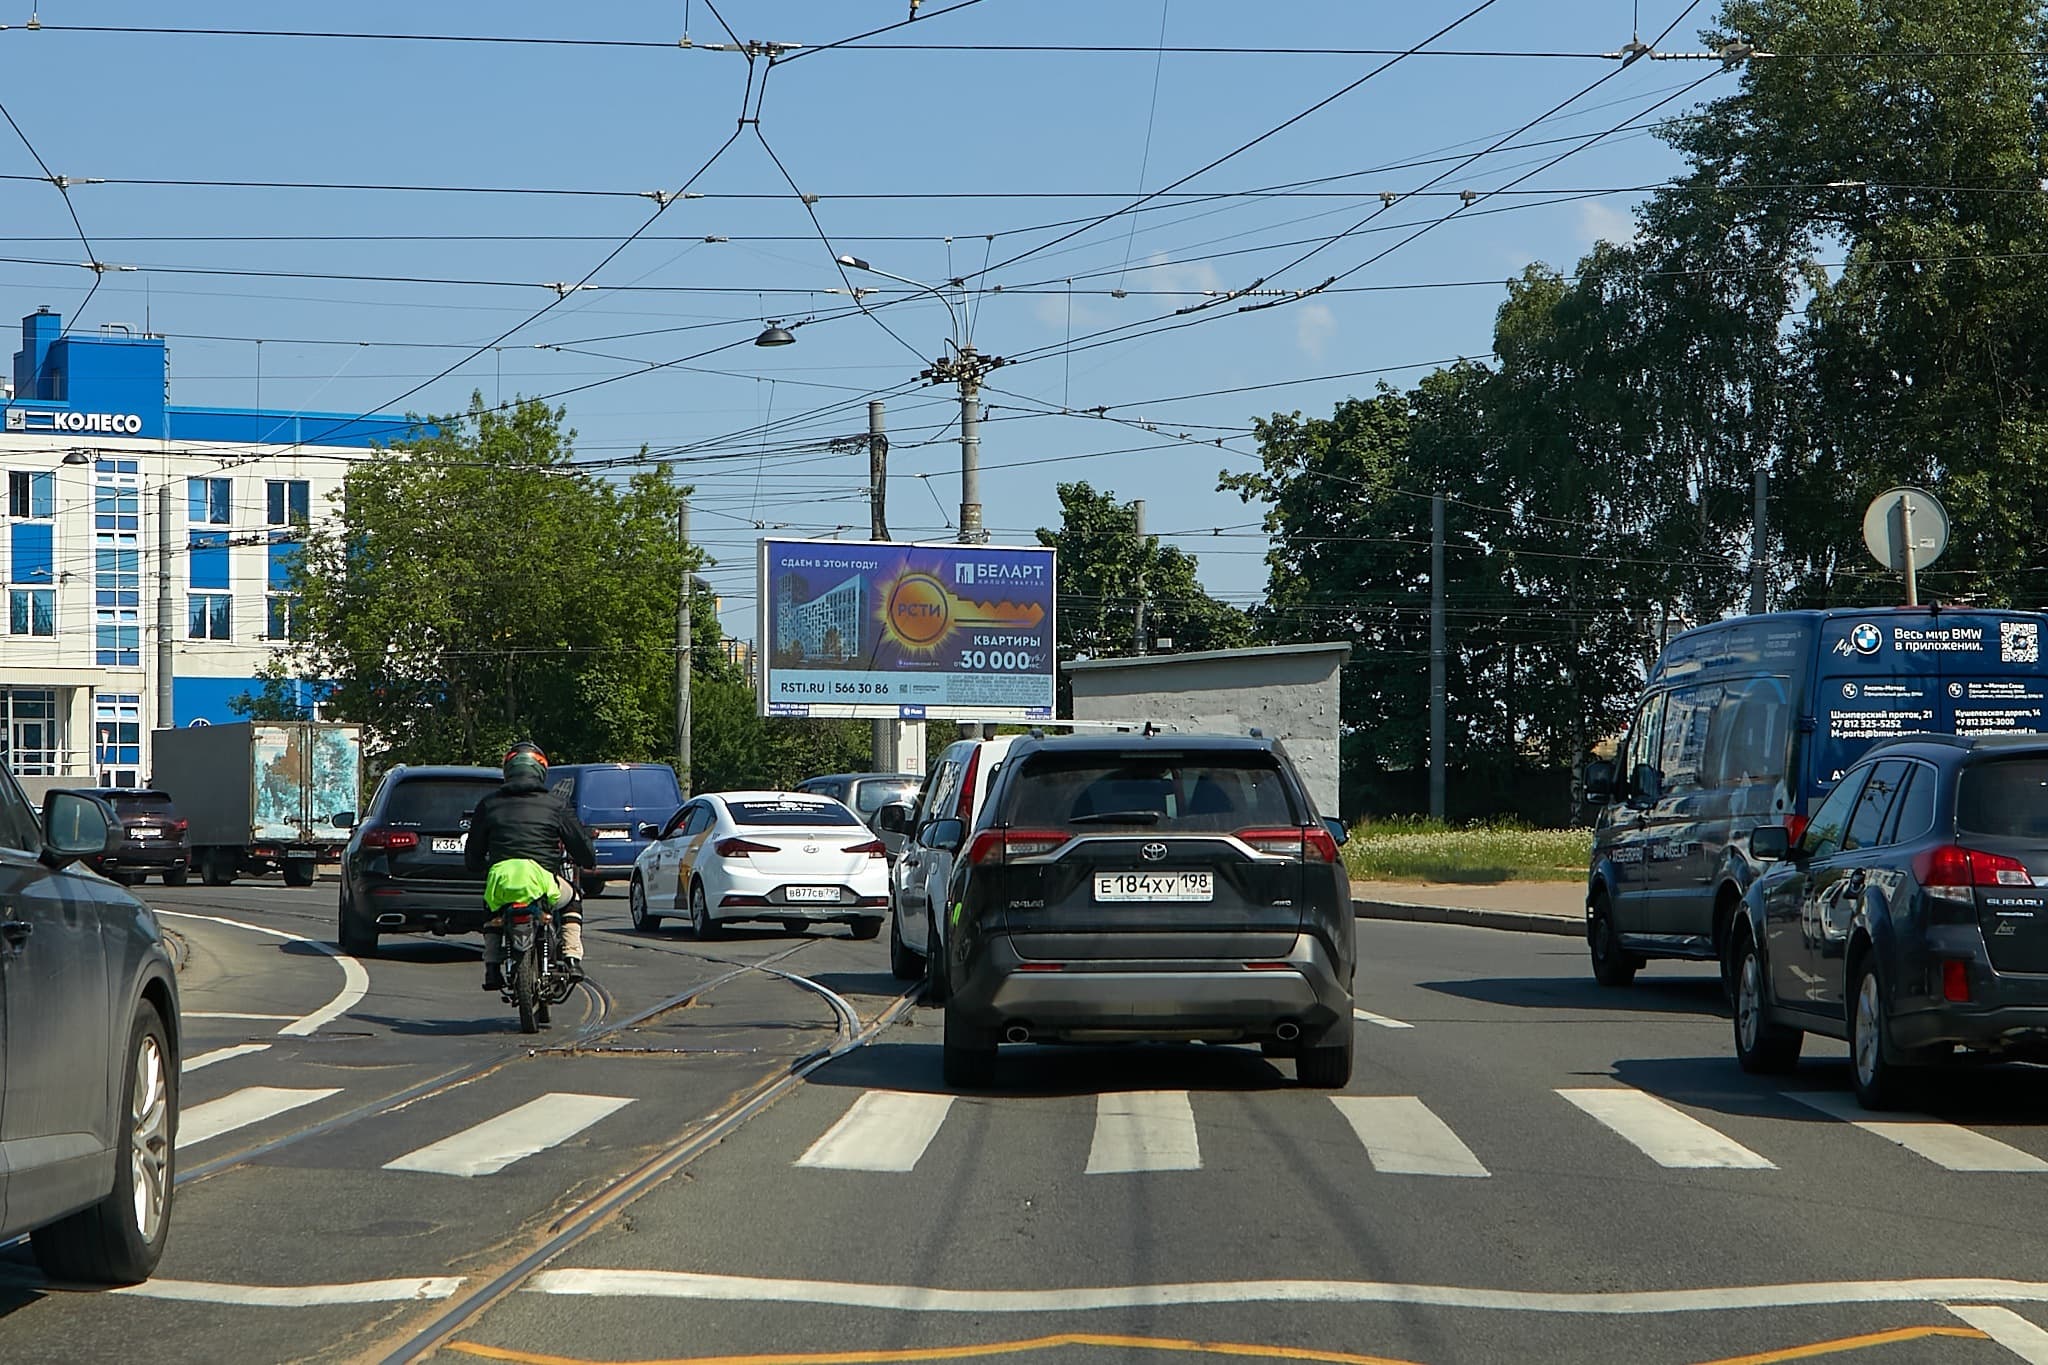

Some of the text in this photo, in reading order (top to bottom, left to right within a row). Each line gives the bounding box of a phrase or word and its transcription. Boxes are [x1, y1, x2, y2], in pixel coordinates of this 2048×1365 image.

[54, 411, 142, 433] КОЛЕСО
[781, 558, 812, 568] СДАЕМ
[823, 560, 848, 568] ЭТОМ
[850, 560, 878, 570] ГОДУ!
[977, 563, 1044, 579] БЕЛАРТ
[897, 603, 940, 617] РСТИ
[973, 635, 1040, 647] КВАРТИРЫ
[1894, 628, 1982, 643] Весь мир BMW
[1895, 640, 1983, 653] в приложении.
[960, 650, 986, 669] 30
[989, 650, 1030, 670] 000
[781, 682, 889, 694] RSTI.RU 566 30 86
[1830, 710, 1933, 721] Шкиперский проток, 21
[2032, 709, 2041, 717] 14
[1831, 720, 1902, 728] +7 812 325-5252
[1955, 718, 2015, 726] +7 812 325-3000
[1100, 873, 1208, 893] Е184ХУ 198
[1985, 898, 2044, 906] SUBARU
